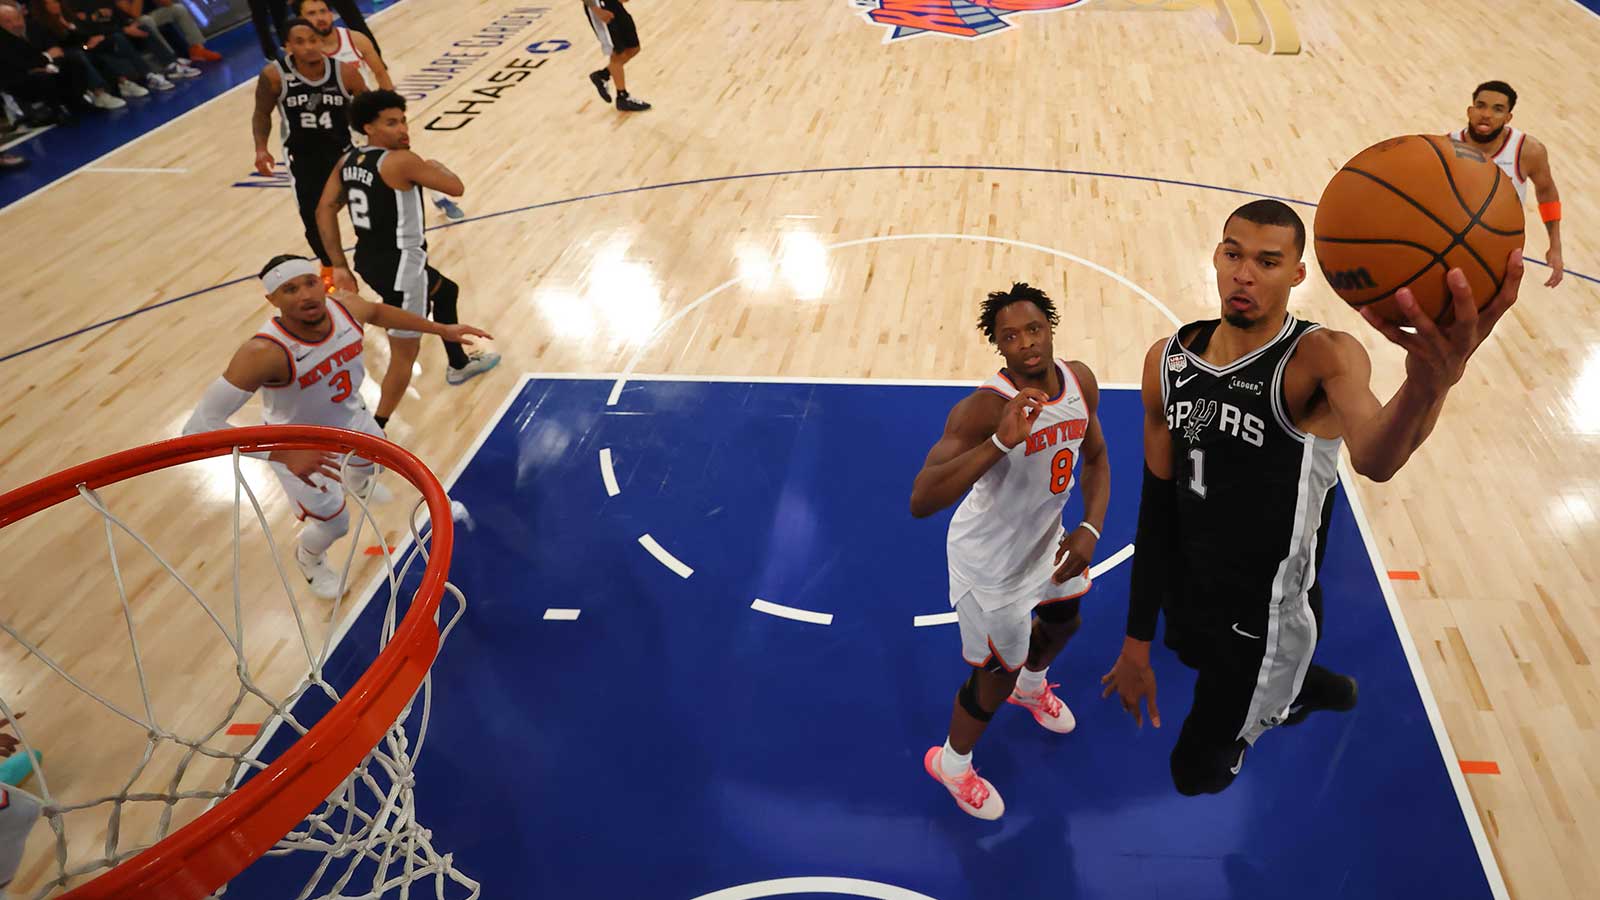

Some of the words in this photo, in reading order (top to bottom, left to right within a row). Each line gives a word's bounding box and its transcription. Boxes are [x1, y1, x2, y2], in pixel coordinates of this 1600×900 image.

[453, 7, 552, 48] GARDEN
[424, 58, 549, 131] CHASE
[300, 111, 334, 129] 24
[343, 166, 374, 187] HARPER
[348, 187, 371, 229] 2
[328, 369, 353, 403] 3
[1232, 379, 1259, 391] LEDGER
[1024, 422, 1058, 457] NEW
[1049, 447, 1074, 495] 8
[1188, 448, 1208, 499] 1
